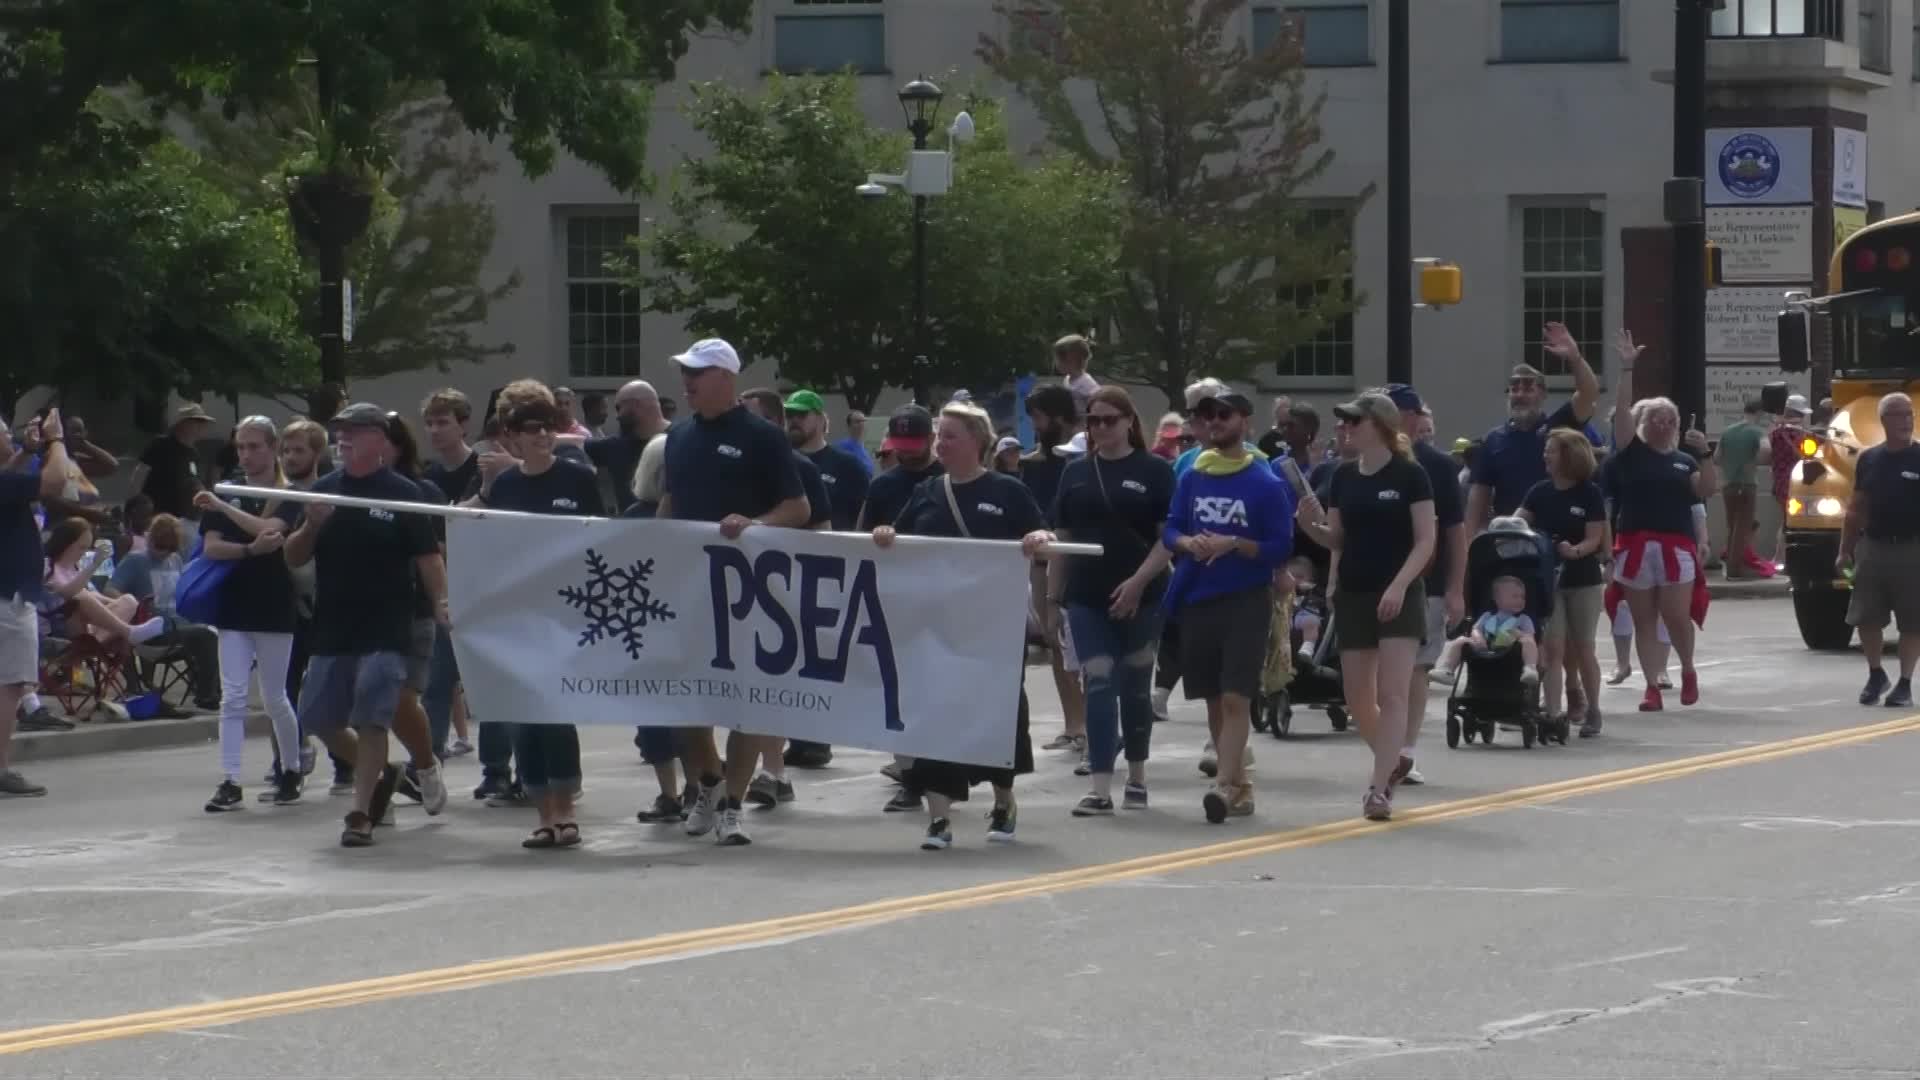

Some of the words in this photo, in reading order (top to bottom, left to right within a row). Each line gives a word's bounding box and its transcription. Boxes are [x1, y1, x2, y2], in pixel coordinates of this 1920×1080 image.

[1193, 496, 1248, 528] PSEA
[703, 544, 904, 731] PSEA
[560, 677, 743, 699] NORTHWESTERN
[749, 687, 832, 711] REGION
